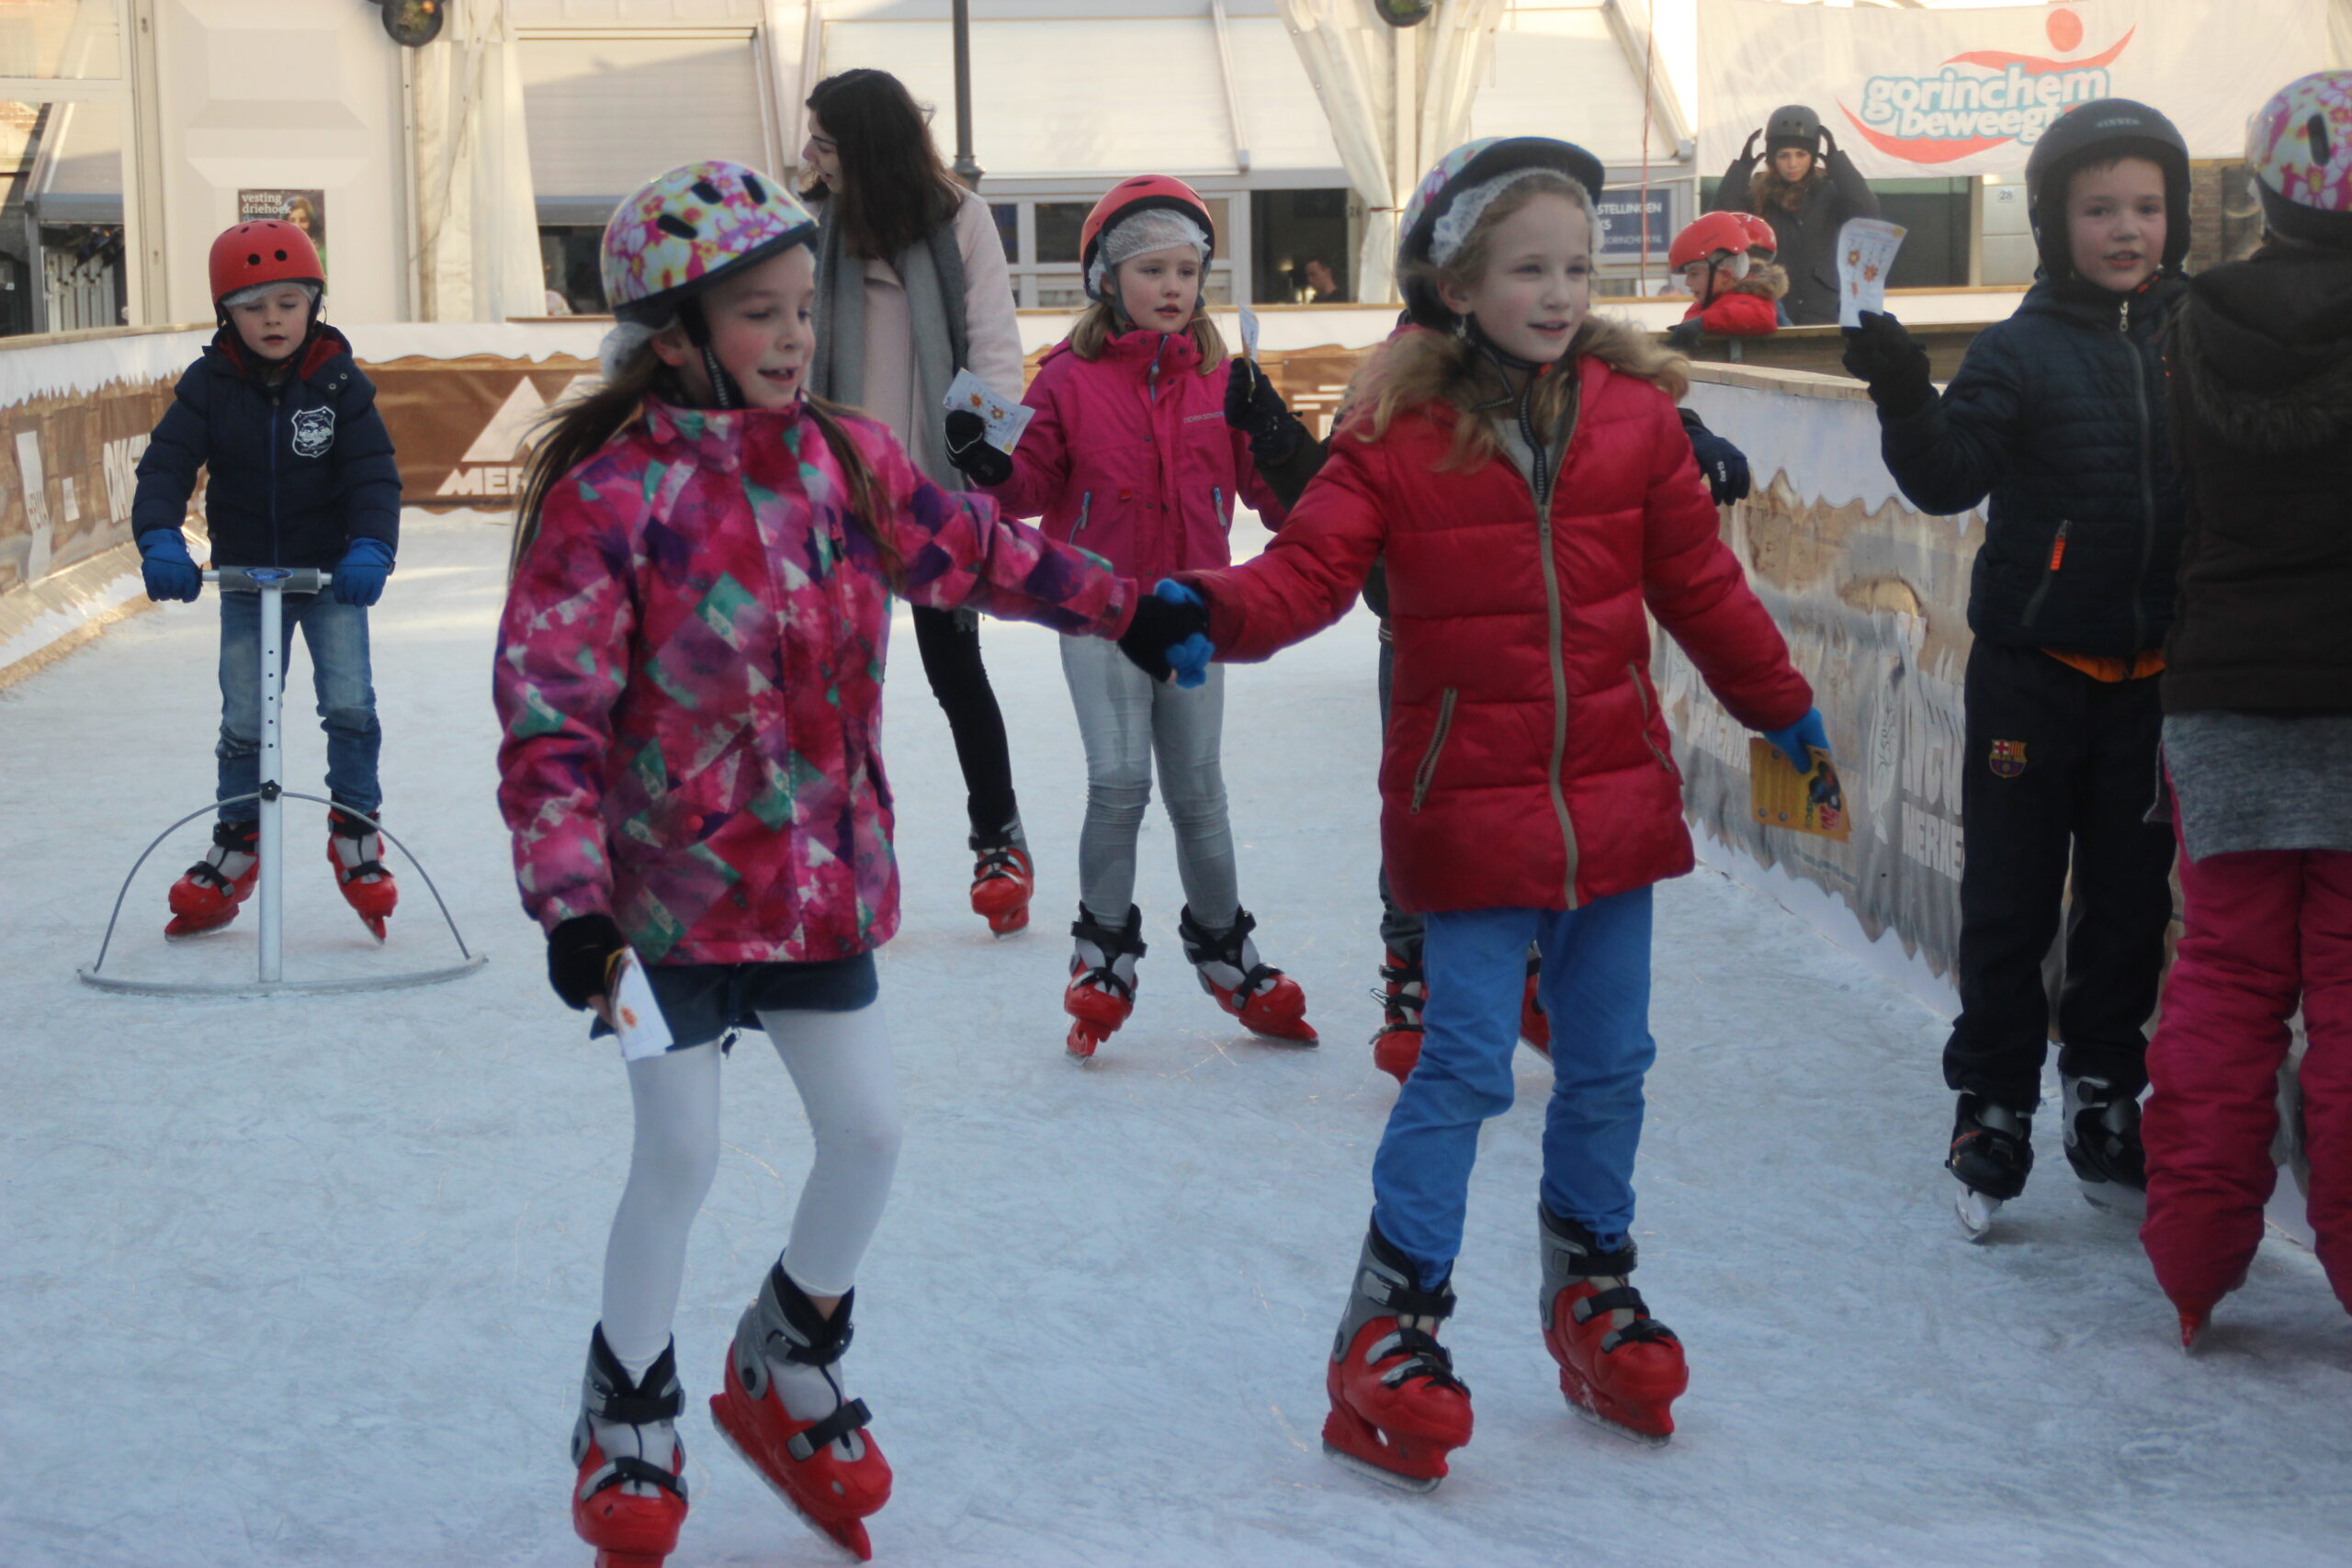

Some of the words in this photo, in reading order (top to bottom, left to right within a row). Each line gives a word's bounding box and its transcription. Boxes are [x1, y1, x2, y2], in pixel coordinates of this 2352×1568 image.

[1861, 63, 2109, 123] gorinchem
[1894, 104, 2064, 144] beweegt
[241, 192, 283, 206] vesting
[242, 203, 292, 214] driehoek
